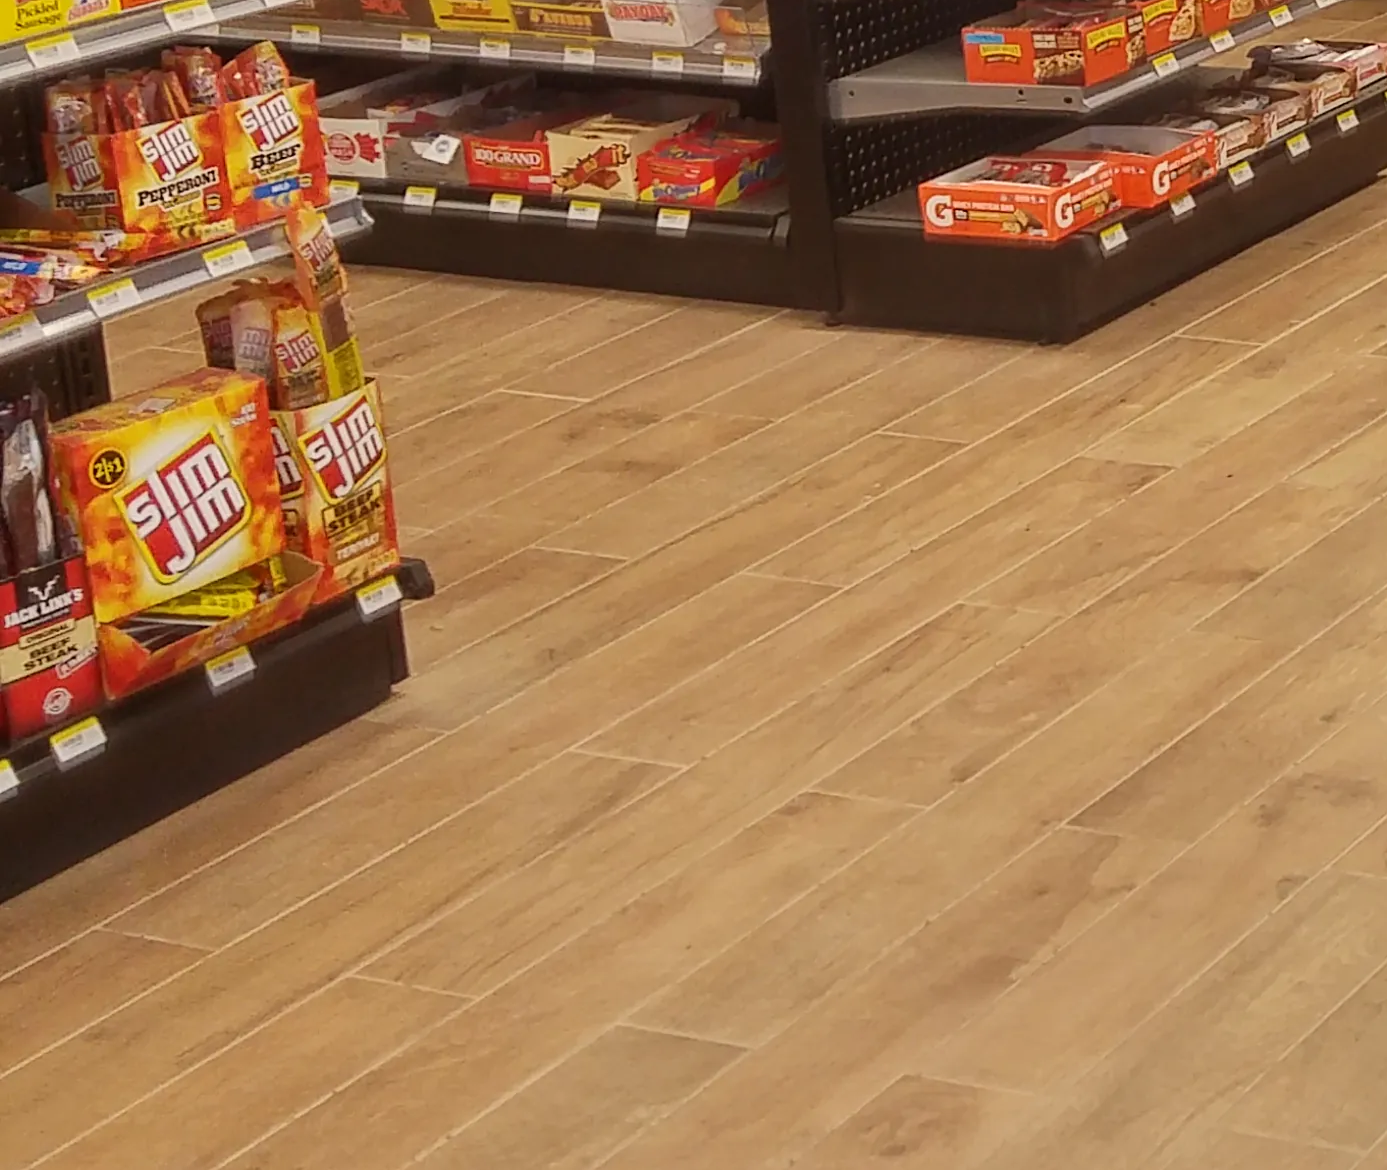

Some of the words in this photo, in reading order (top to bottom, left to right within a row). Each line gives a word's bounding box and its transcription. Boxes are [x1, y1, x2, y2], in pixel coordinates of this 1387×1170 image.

[15, 14, 62, 31] Sausage
[17, 2, 60, 20] Pickled
[250, 143, 301, 171] BEEF
[494, 151, 541, 166] GRAND
[137, 170, 218, 208] PEPPERONI
[925, 194, 954, 228] G
[327, 501, 383, 534] STEAK
[4, 605, 41, 629] JACK
[23, 645, 79, 673] STEAK
[28, 638, 70, 660] BEEF
